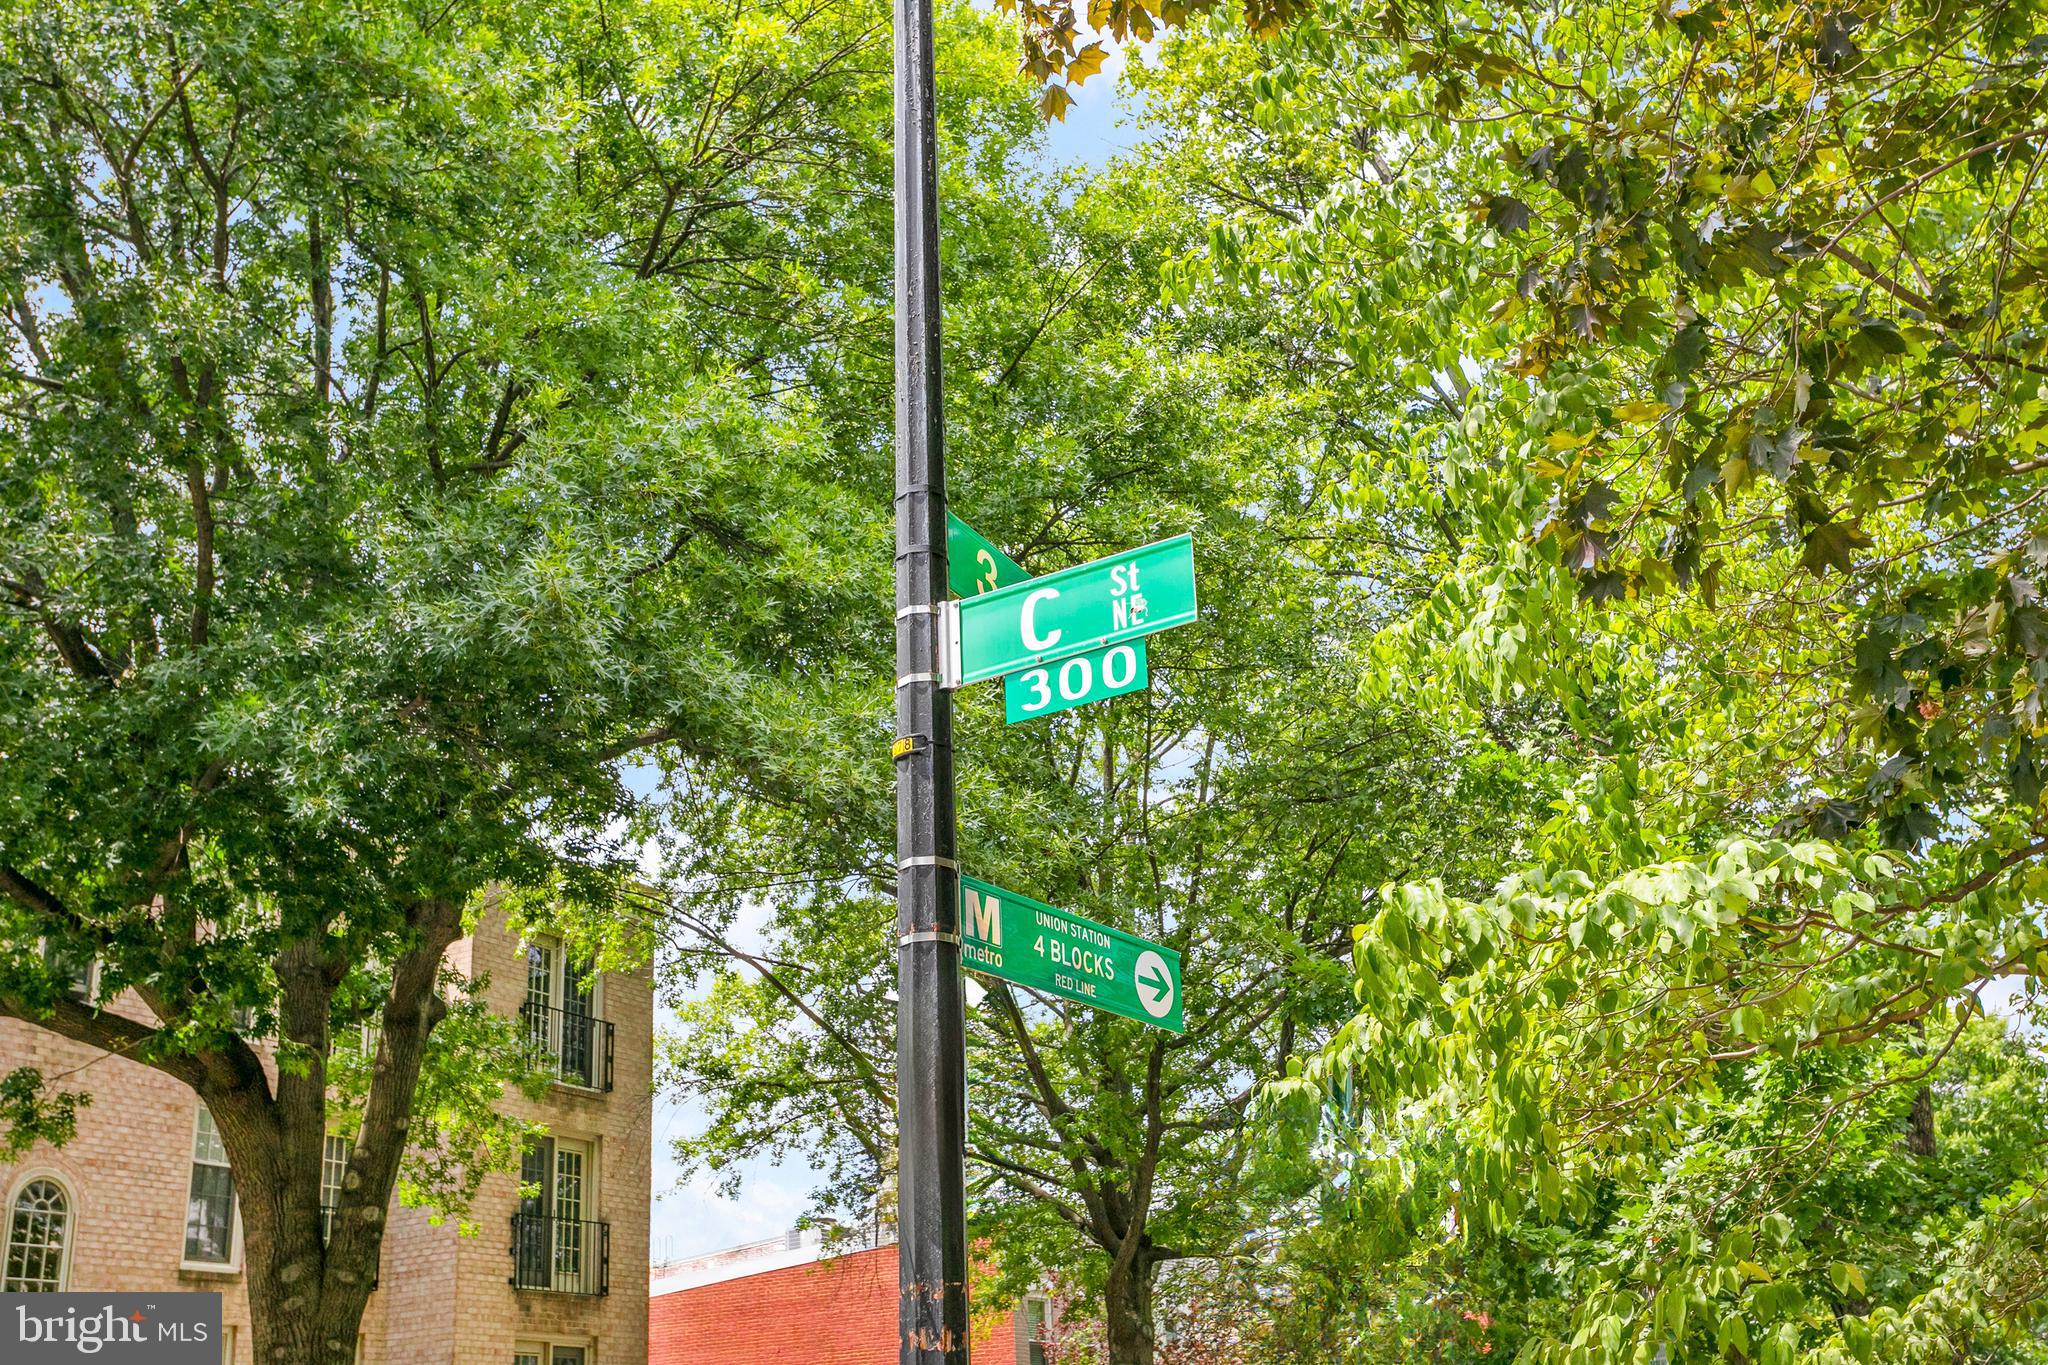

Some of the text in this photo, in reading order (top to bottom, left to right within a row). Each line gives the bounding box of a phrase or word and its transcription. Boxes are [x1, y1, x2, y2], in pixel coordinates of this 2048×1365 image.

[976, 549, 998, 593] 3
[1110, 561, 1140, 597] St
[1020, 588, 1062, 651] C
[1112, 593, 1146, 631] NE
[1019, 645, 1137, 712] 300
[964, 887, 1001, 945] M
[1035, 911, 1111, 949] UNION STATION
[963, 942, 1003, 968] metro
[1033, 935, 1115, 981] 4 BLOCKS
[1055, 973, 1097, 998] RED LINE
